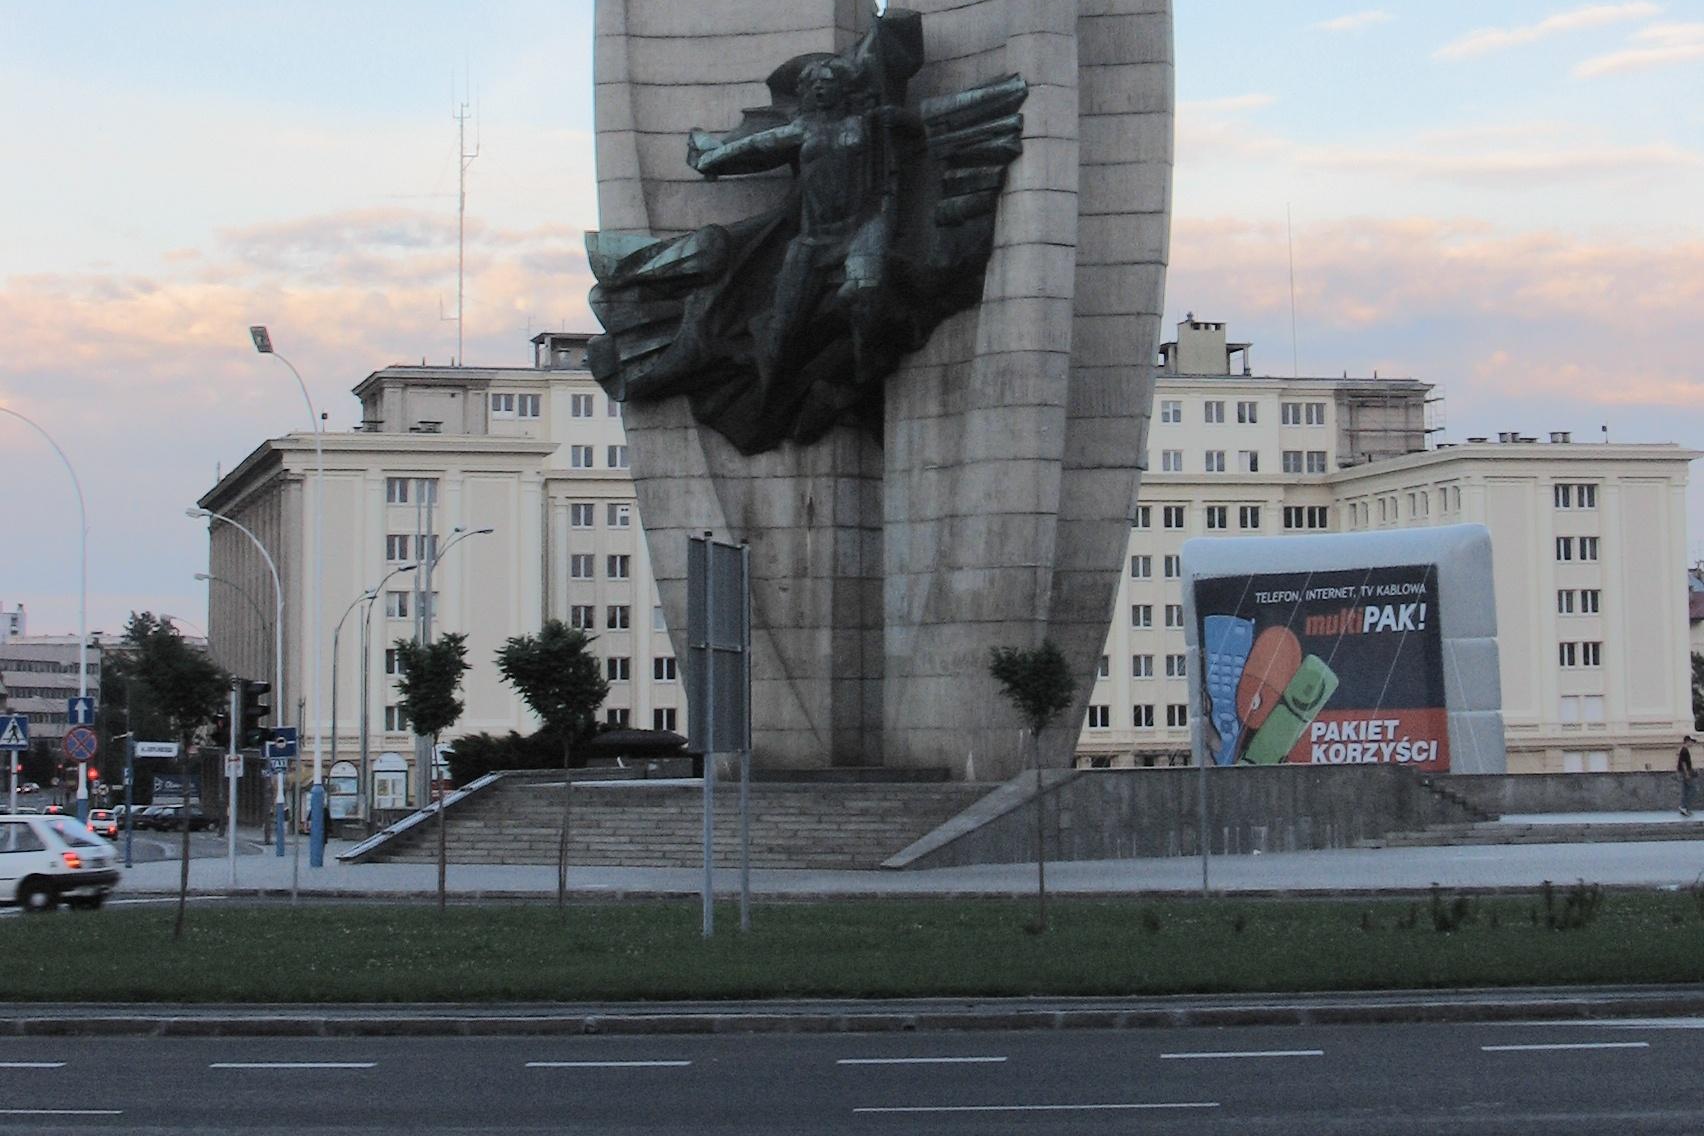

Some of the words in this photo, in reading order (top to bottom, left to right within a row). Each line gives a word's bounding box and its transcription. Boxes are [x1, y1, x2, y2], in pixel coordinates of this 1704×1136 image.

[1361, 585, 1374, 596] TV
[1311, 719, 1400, 742] PAKIET
[1311, 736, 1438, 764] KORZYŚCI
